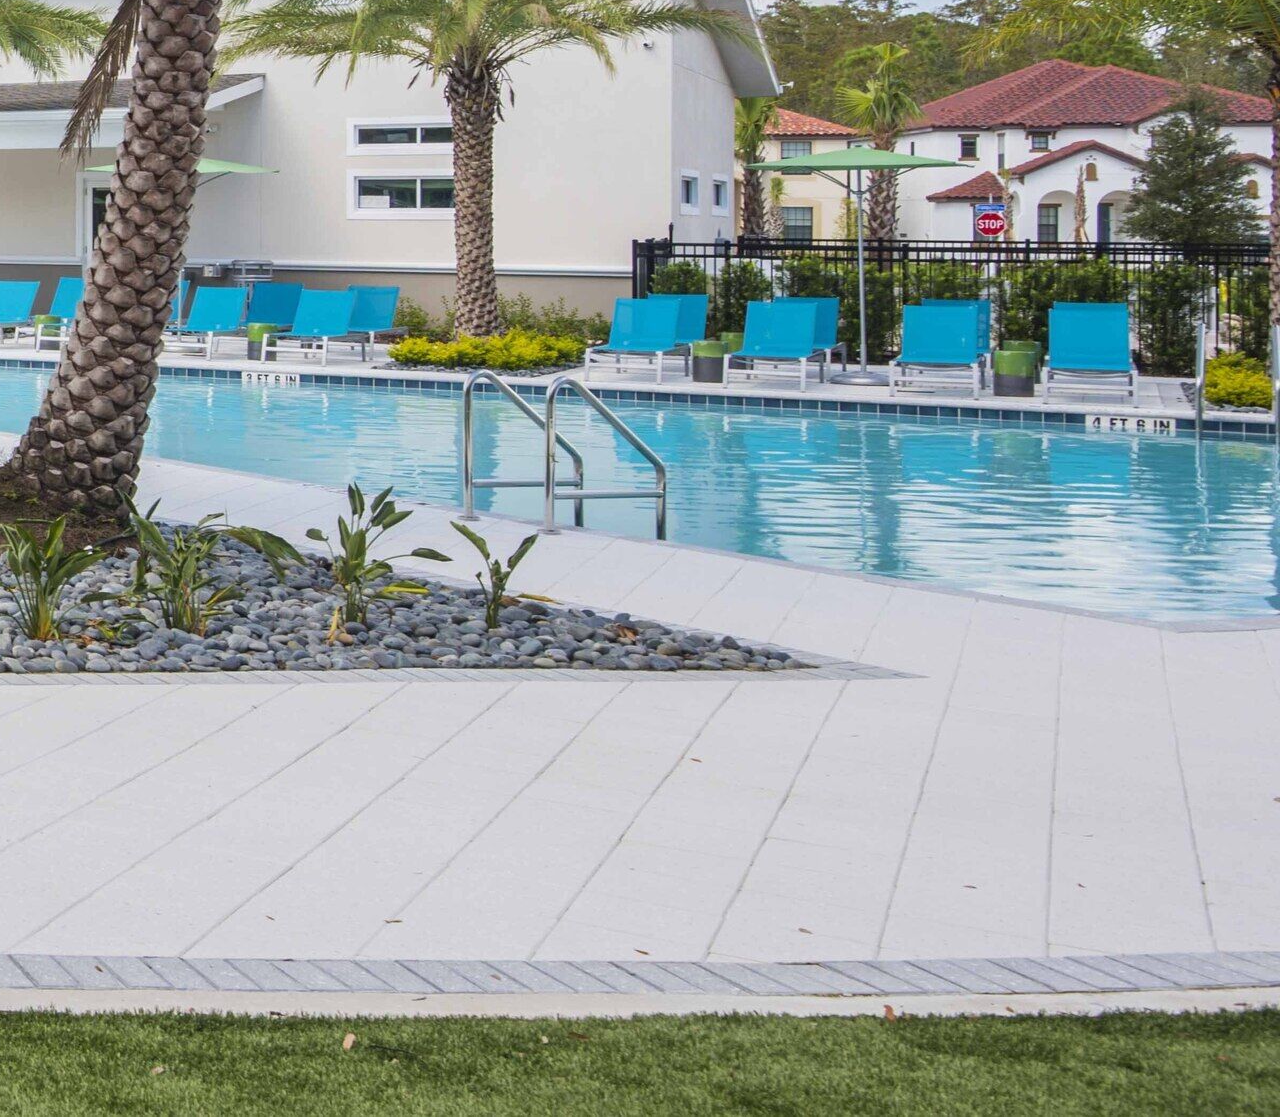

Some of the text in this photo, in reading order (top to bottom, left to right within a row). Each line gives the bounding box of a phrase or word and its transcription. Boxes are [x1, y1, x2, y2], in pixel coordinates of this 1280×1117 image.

[978, 219, 1004, 229] STOP
[1109, 417, 1128, 427] FT
[1153, 420, 1170, 429] IN
